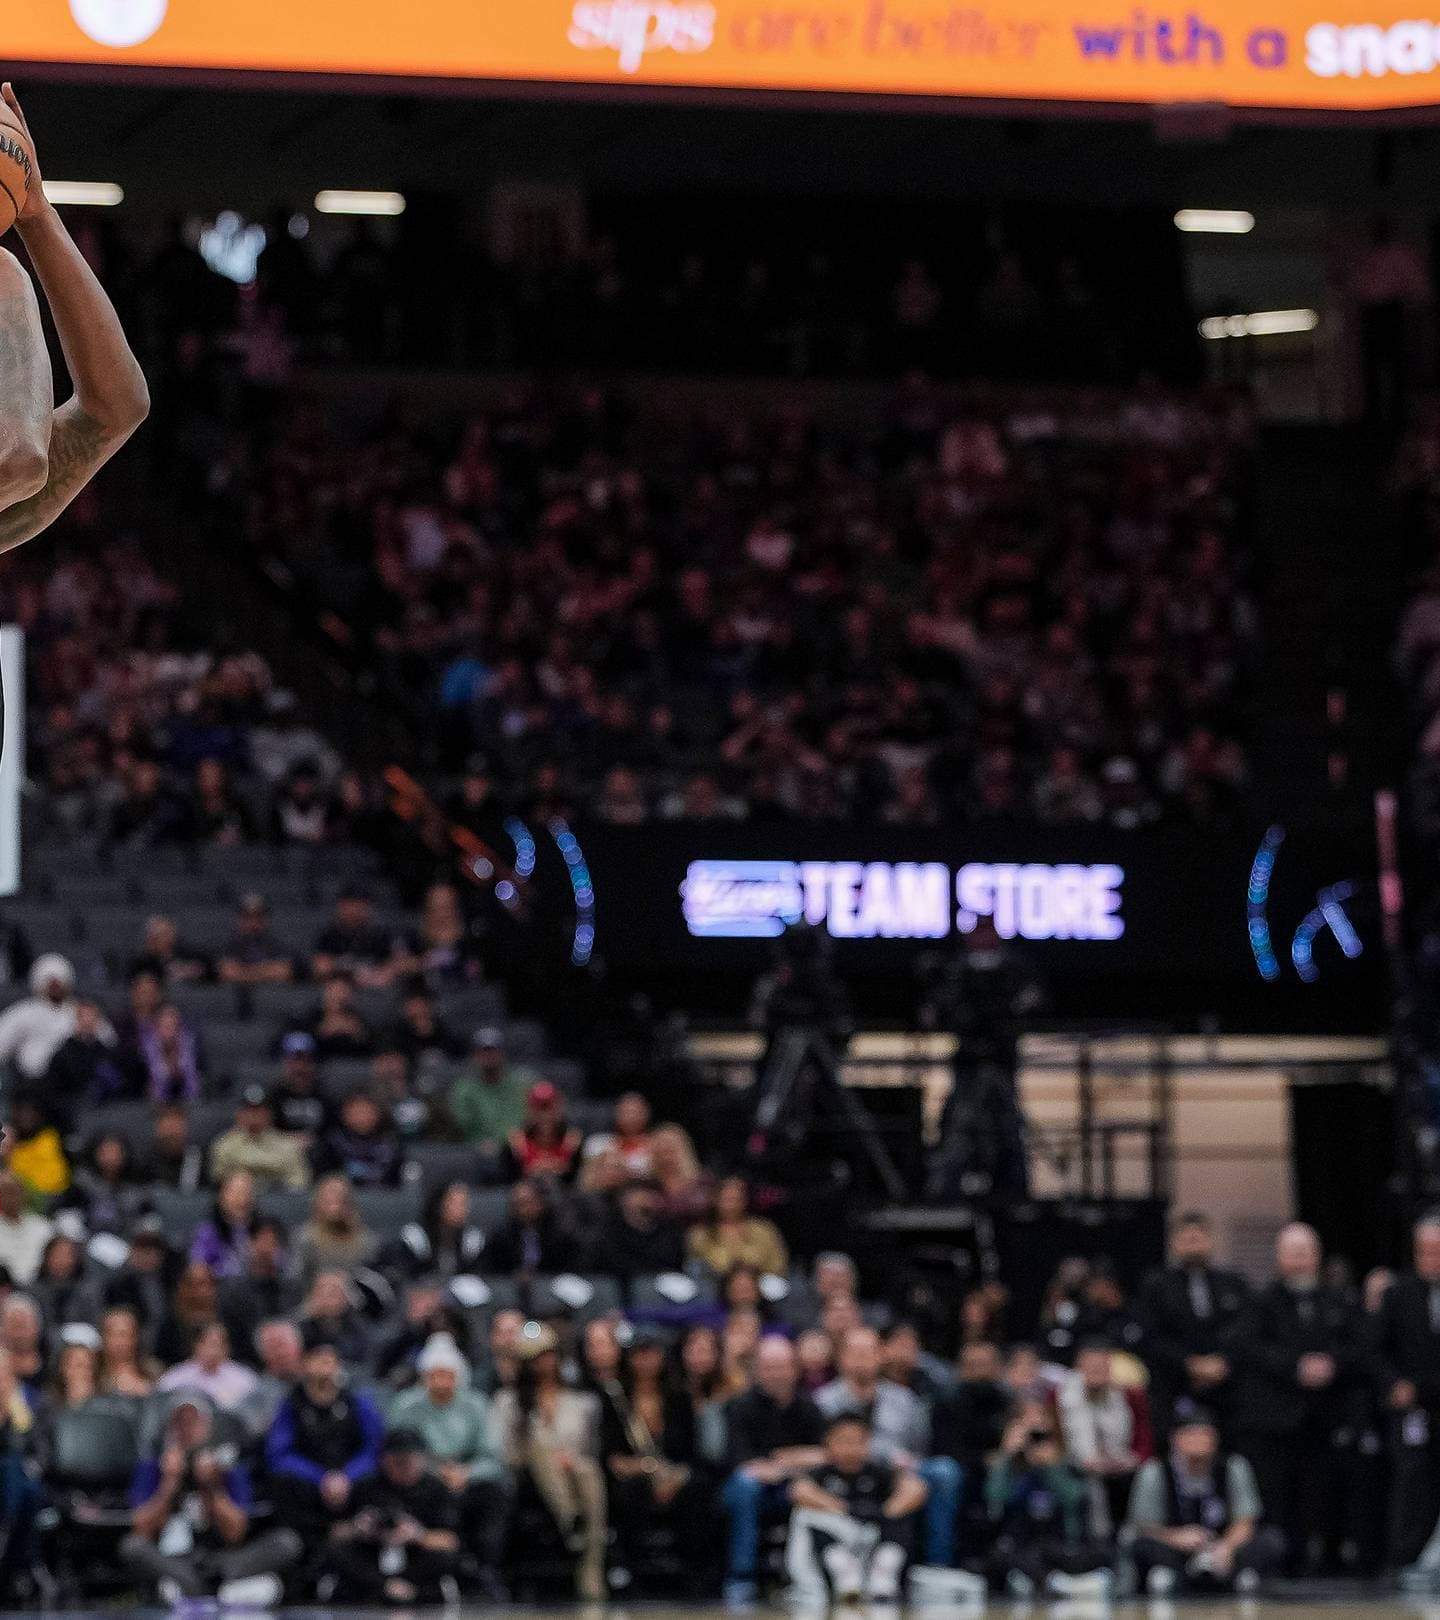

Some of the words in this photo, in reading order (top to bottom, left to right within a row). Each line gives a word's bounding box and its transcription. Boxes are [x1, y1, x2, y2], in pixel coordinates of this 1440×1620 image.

[568, 0, 715, 74] sips
[730, 10, 855, 53] are
[1073, 8, 1225, 65] with
[1247, 27, 1288, 68] a
[1304, 20, 1440, 78] sna
[799, 861, 951, 938] TEAM
[957, 863, 1125, 940] STORE
